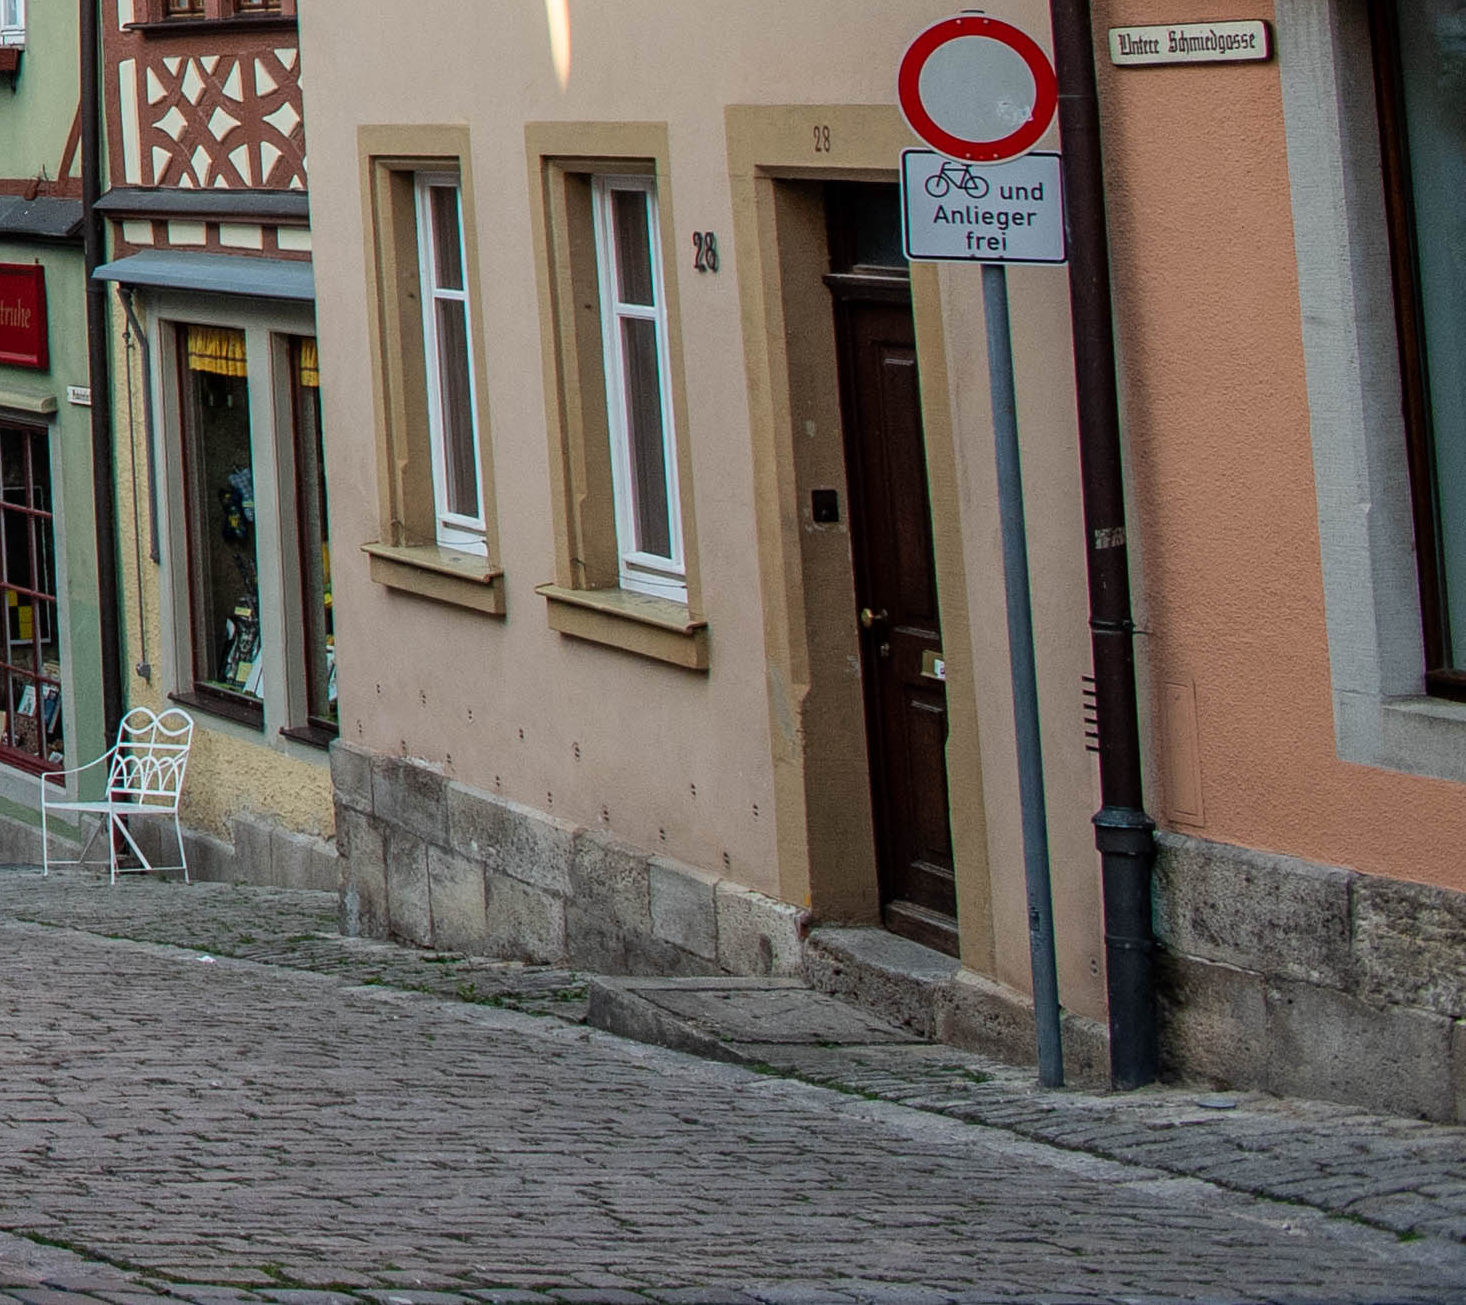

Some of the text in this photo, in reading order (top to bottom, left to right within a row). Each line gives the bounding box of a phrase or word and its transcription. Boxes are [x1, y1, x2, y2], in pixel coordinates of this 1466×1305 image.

[1118, 29, 1256, 56] Untere Schmiedgasse
[813, 125, 831, 153] 28
[1000, 181, 1044, 202] und
[933, 205, 1037, 229] Anlieger
[692, 231, 718, 272] 28
[966, 231, 1007, 251] frei
